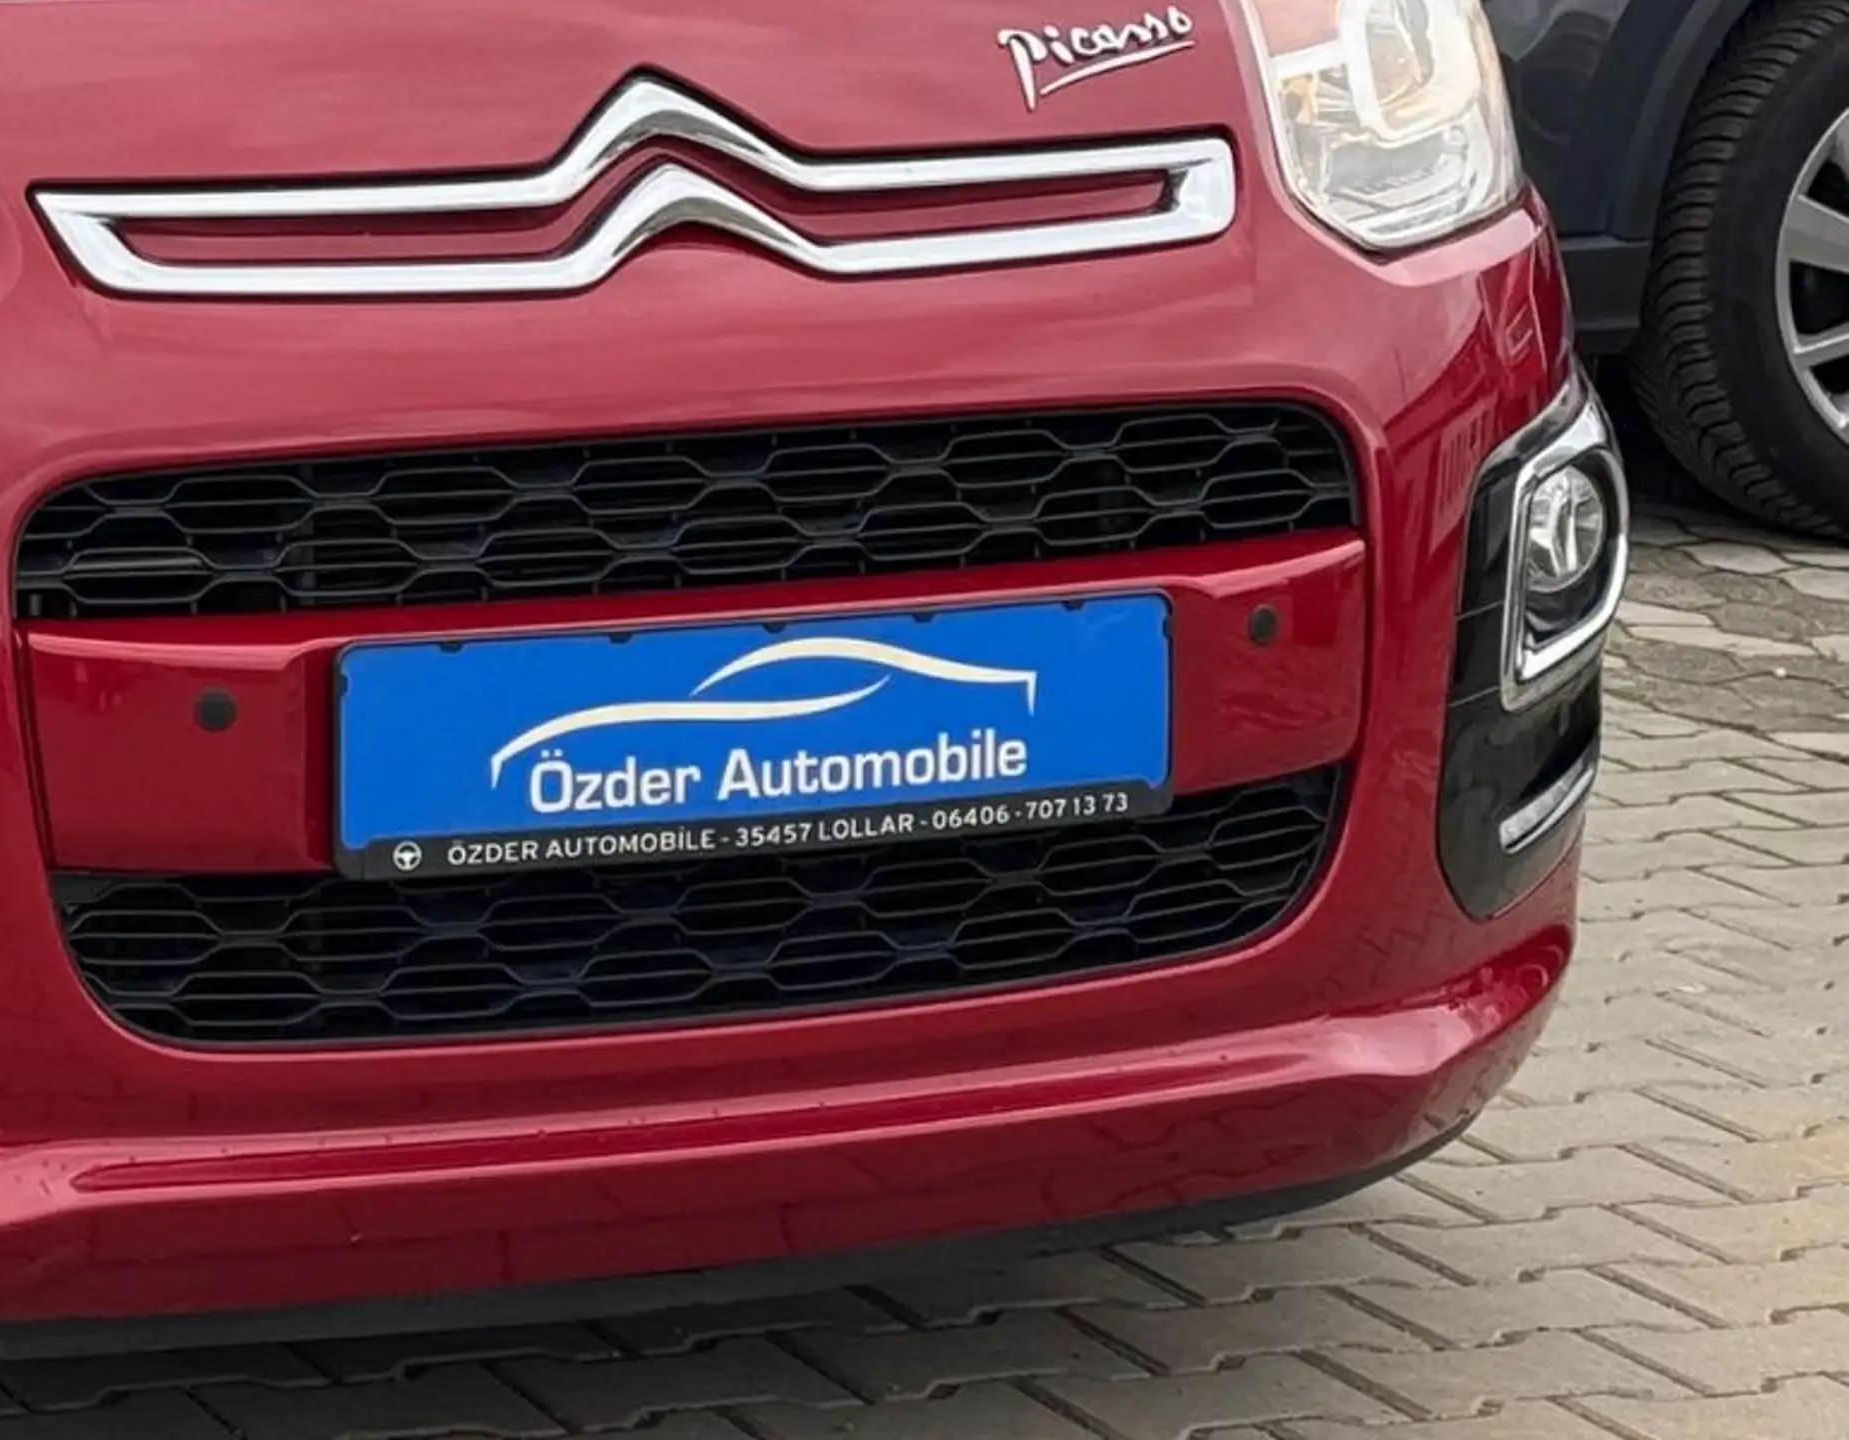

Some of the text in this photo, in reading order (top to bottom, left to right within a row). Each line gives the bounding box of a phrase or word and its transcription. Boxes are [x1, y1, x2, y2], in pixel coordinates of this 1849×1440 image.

[997, 6, 1194, 112] Picasso
[529, 727, 1028, 814] Özder Automobile
[447, 839, 538, 866] ÖZDER
[734, 821, 812, 848] 35457
[818, 812, 915, 842] LOLLAR
[931, 803, 1011, 830] 06406
[1025, 798, 1066, 820] 707
[1072, 794, 1097, 816] 13
[1103, 791, 1129, 812] 73
